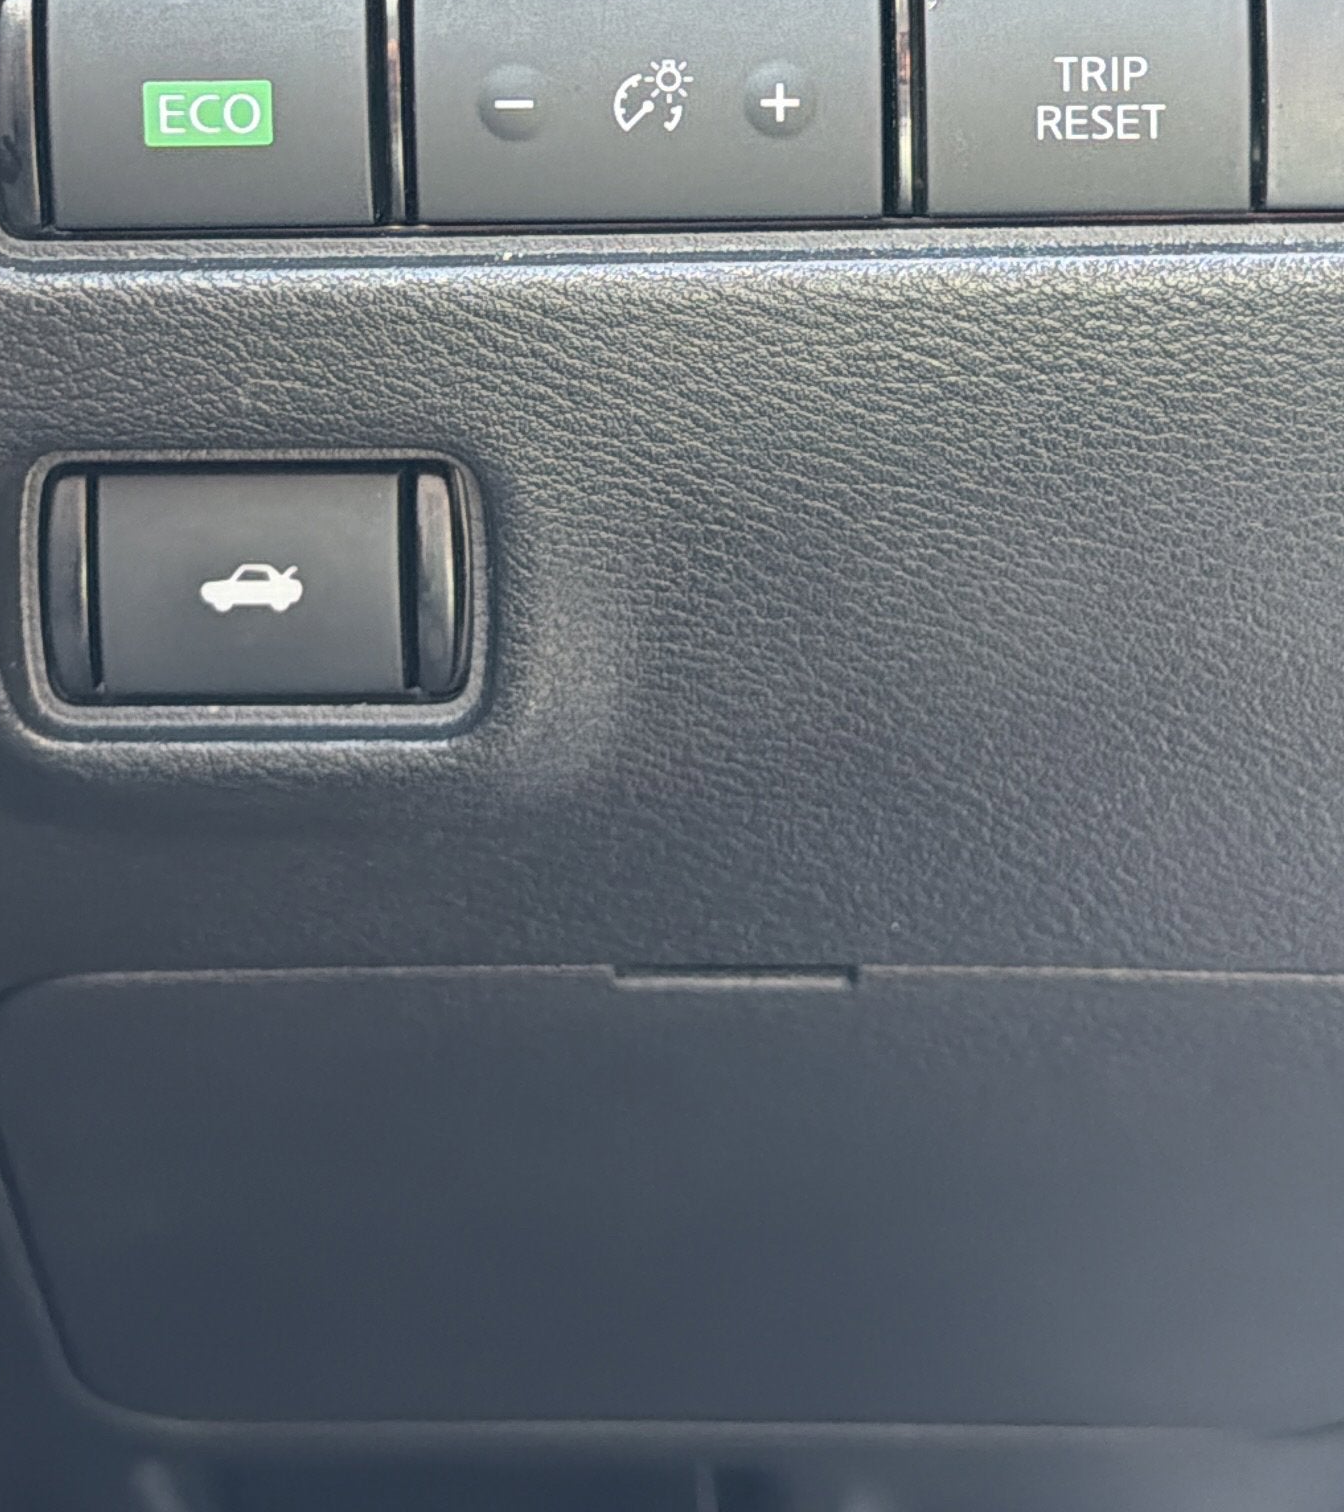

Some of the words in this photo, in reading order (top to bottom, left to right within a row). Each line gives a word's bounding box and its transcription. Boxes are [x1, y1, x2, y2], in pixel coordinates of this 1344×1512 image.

[1053, 55, 1149, 93] TRIP
[158, 93, 262, 135] ECO
[1036, 103, 1167, 141] RESET
